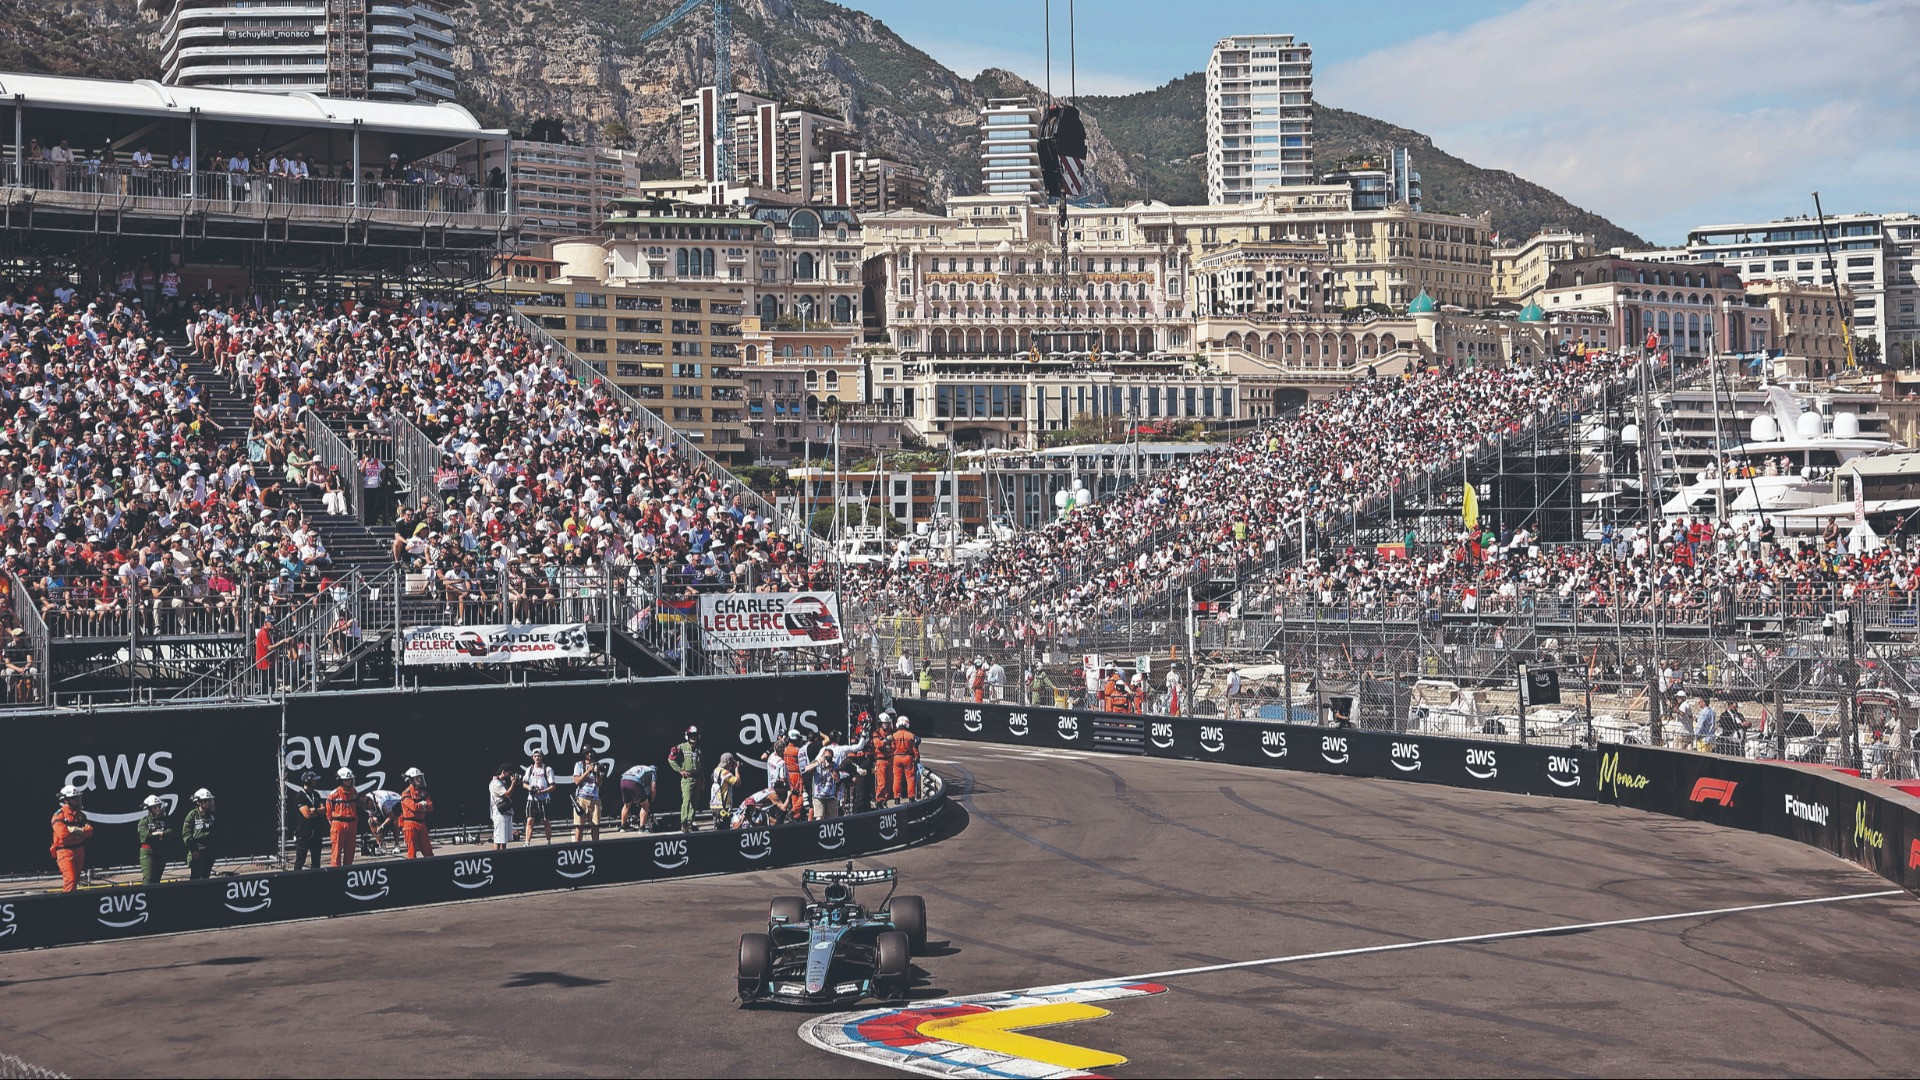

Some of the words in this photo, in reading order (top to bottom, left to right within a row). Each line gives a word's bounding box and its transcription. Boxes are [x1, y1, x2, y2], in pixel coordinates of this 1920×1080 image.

[714, 599, 784, 613] CHARLES
[704, 613, 784, 632] LECLERC
[412, 632, 455, 641] CHARLES
[489, 634, 515, 643] HAI
[519, 633, 550, 643] DUE
[406, 641, 455, 651] LECLERC
[965, 709, 982, 723] aws
[1009, 713, 1028, 726] aws
[1058, 716, 1078, 731] aws
[739, 710, 819, 745] aws
[1151, 722, 1173, 738] aws
[1200, 726, 1224, 741] aws
[524, 721, 611, 758] aws
[1262, 731, 1286, 747] aws
[1322, 736, 1348, 753] aws
[285, 732, 382, 771] aws
[1391, 742, 1420, 760] aws
[1466, 749, 1497, 767] aws
[64, 751, 174, 792] aws
[1547, 756, 1580, 775] aws
[1599, 752, 1650, 799] Monaco
[819, 822, 844, 839] aws
[879, 813, 898, 830] aws
[1854, 800, 1884, 849] Monco
[740, 830, 772, 848] aws
[557, 847, 595, 866] aws
[654, 839, 689, 858] aws
[454, 858, 493, 876] aws
[346, 867, 389, 888] aws
[226, 879, 270, 900] aws
[99, 893, 148, 915] aws
